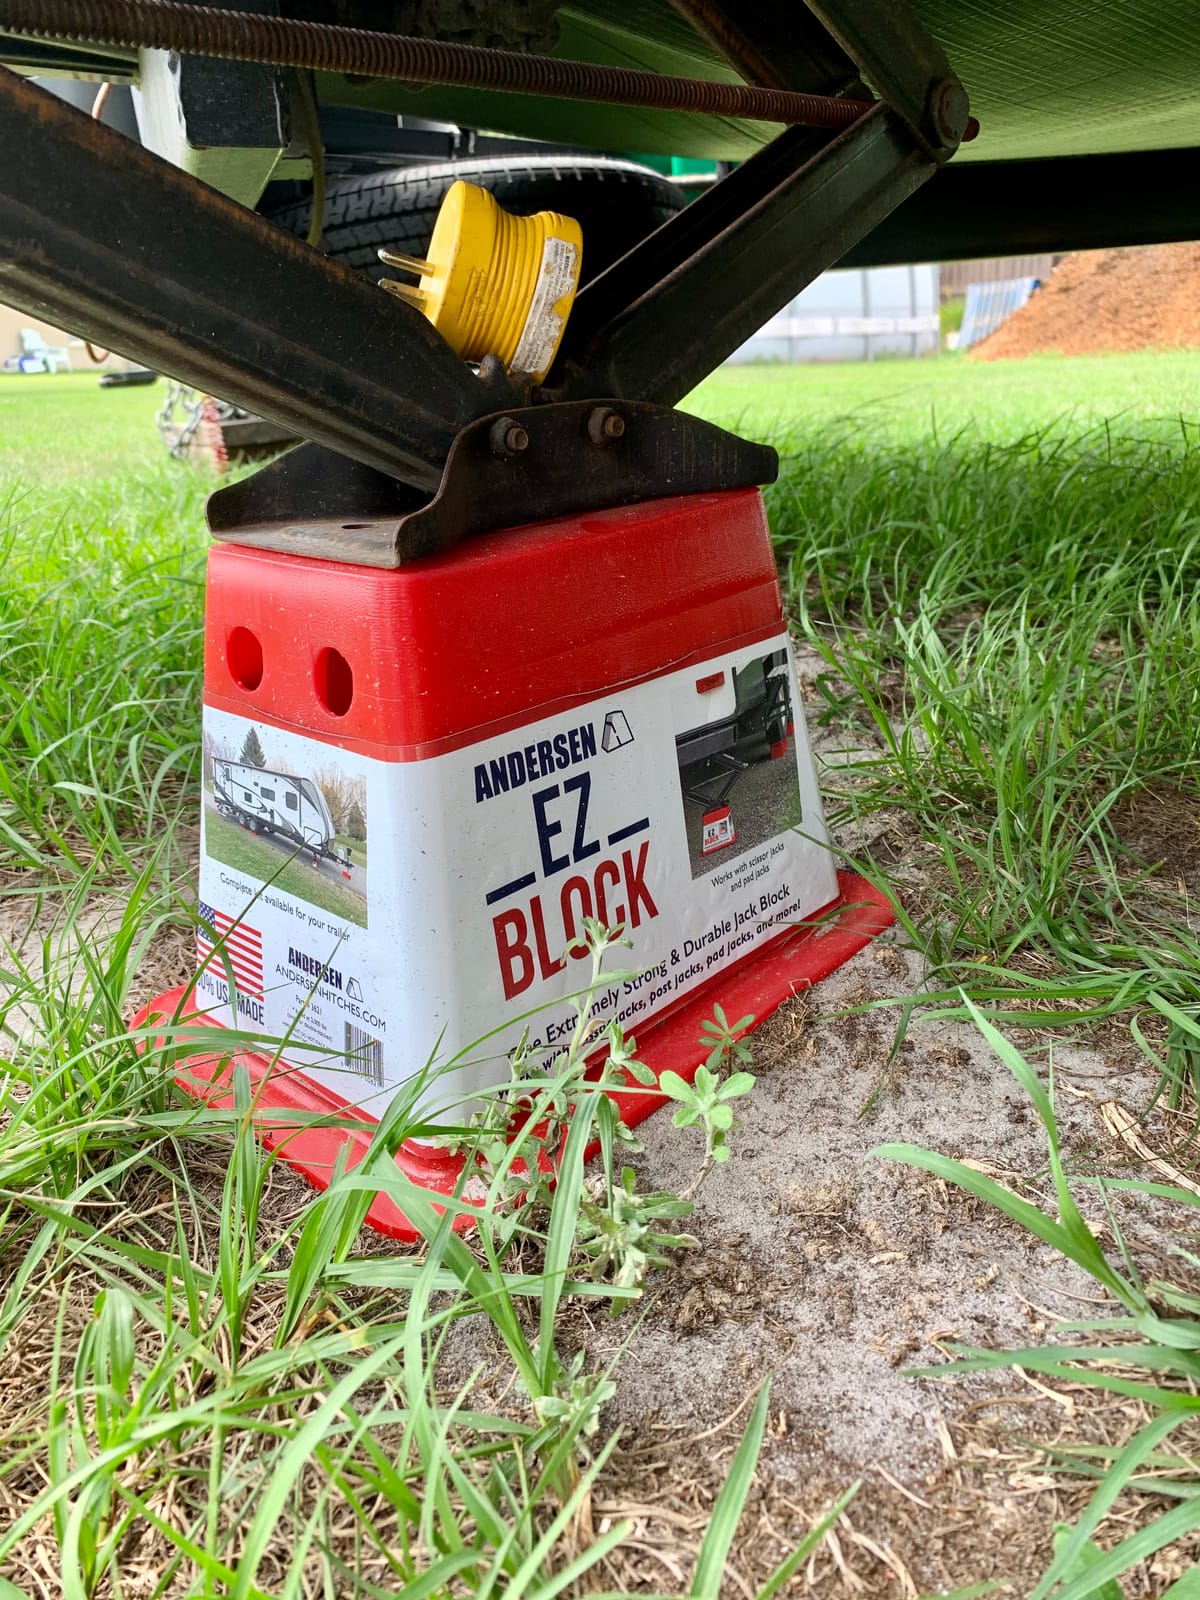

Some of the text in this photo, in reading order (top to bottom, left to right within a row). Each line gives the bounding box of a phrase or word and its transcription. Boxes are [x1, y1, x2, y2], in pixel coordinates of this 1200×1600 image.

[473, 722, 597, 804] ANDERSEN
[532, 771, 601, 878] EZ
[711, 842, 785, 888] Works with scissor jacks
[730, 864, 770, 893] and pad jacks
[219, 872, 252, 896] Complete
[264, 894, 294, 916] available
[295, 906, 306, 920] for
[307, 915, 325, 930] your
[327, 924, 351, 942] trailer
[492, 840, 659, 1002] BLOCK
[288, 946, 343, 991] ANDERSEN
[545, 884, 790, 1044] Extrmely Strong & Durable Jack Block
[649, 980, 672, 1006] post
[674, 963, 704, 990] jacks,
[706, 945, 724, 969] pad
[727, 931, 754, 956] jacks,
[756, 915, 774, 935] and
[775, 899, 801, 922] more!
[236, 992, 264, 1026] MADE
[275, 963, 387, 1033] ANDERSENHITCHES.COM
